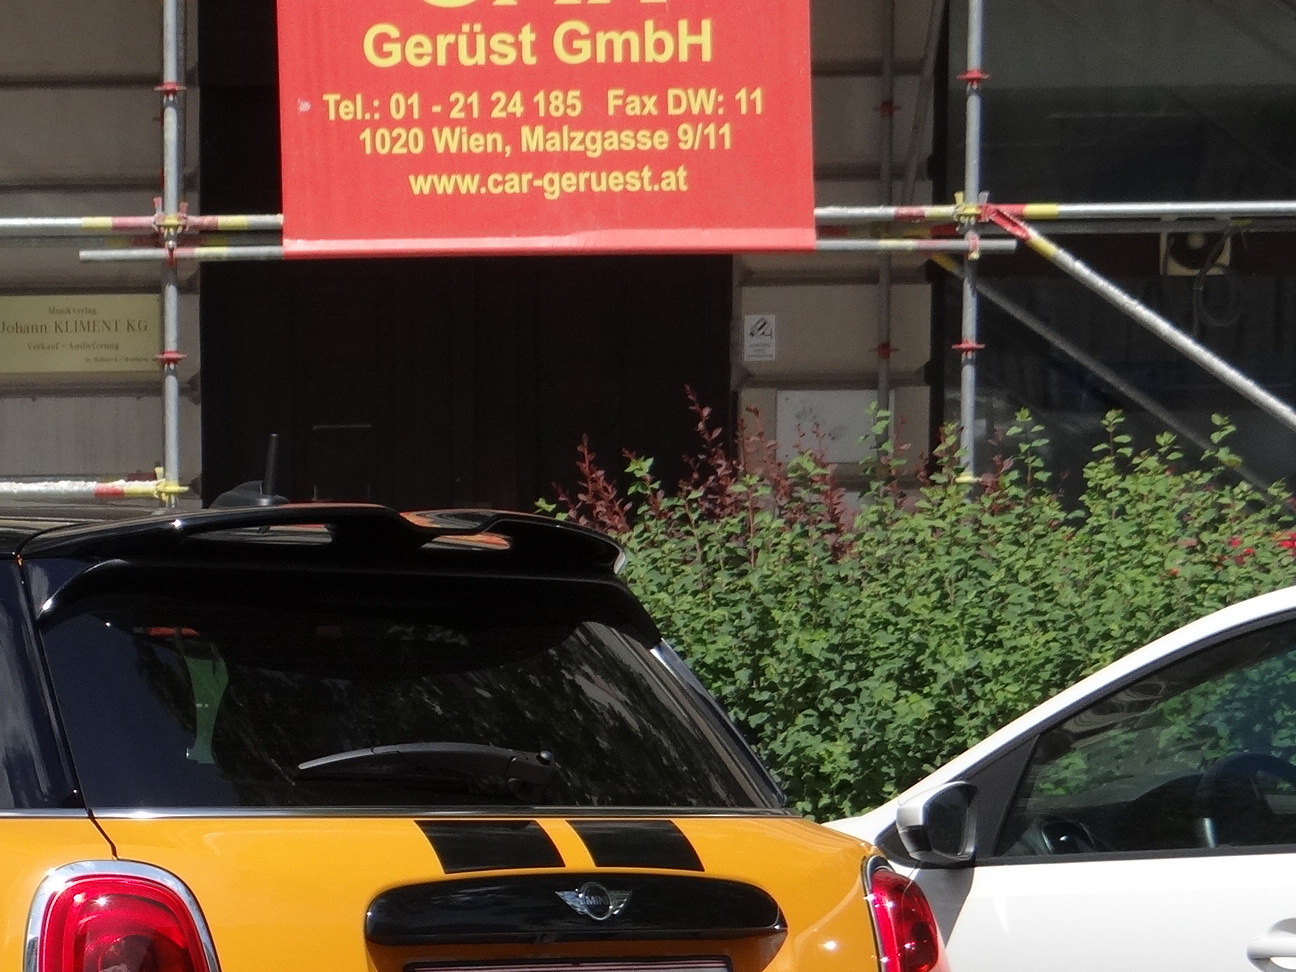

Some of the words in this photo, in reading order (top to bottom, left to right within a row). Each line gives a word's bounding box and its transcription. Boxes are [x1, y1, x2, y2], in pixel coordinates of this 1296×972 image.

[364, 23, 538, 68] Gerüst
[553, 19, 713, 65] GmbH
[323, 94, 380, 121] Tel.:
[390, 93, 420, 120] 01
[450, 92, 479, 119] 21
[491, 91, 525, 118] 24
[534, 90, 582, 118] 185
[608, 89, 658, 116] Fax
[668, 88, 724, 116] DW:
[736, 88, 763, 115] 11
[360, 127, 425, 155] 1020
[432, 127, 511, 157] Wien,
[521, 125, 670, 158] Malzgasse
[678, 123, 731, 150] 9/11
[409, 166, 688, 200] www.car-geruest.at
[0, 320, 47, 335] Johann
[126, 318, 148, 332] KG
